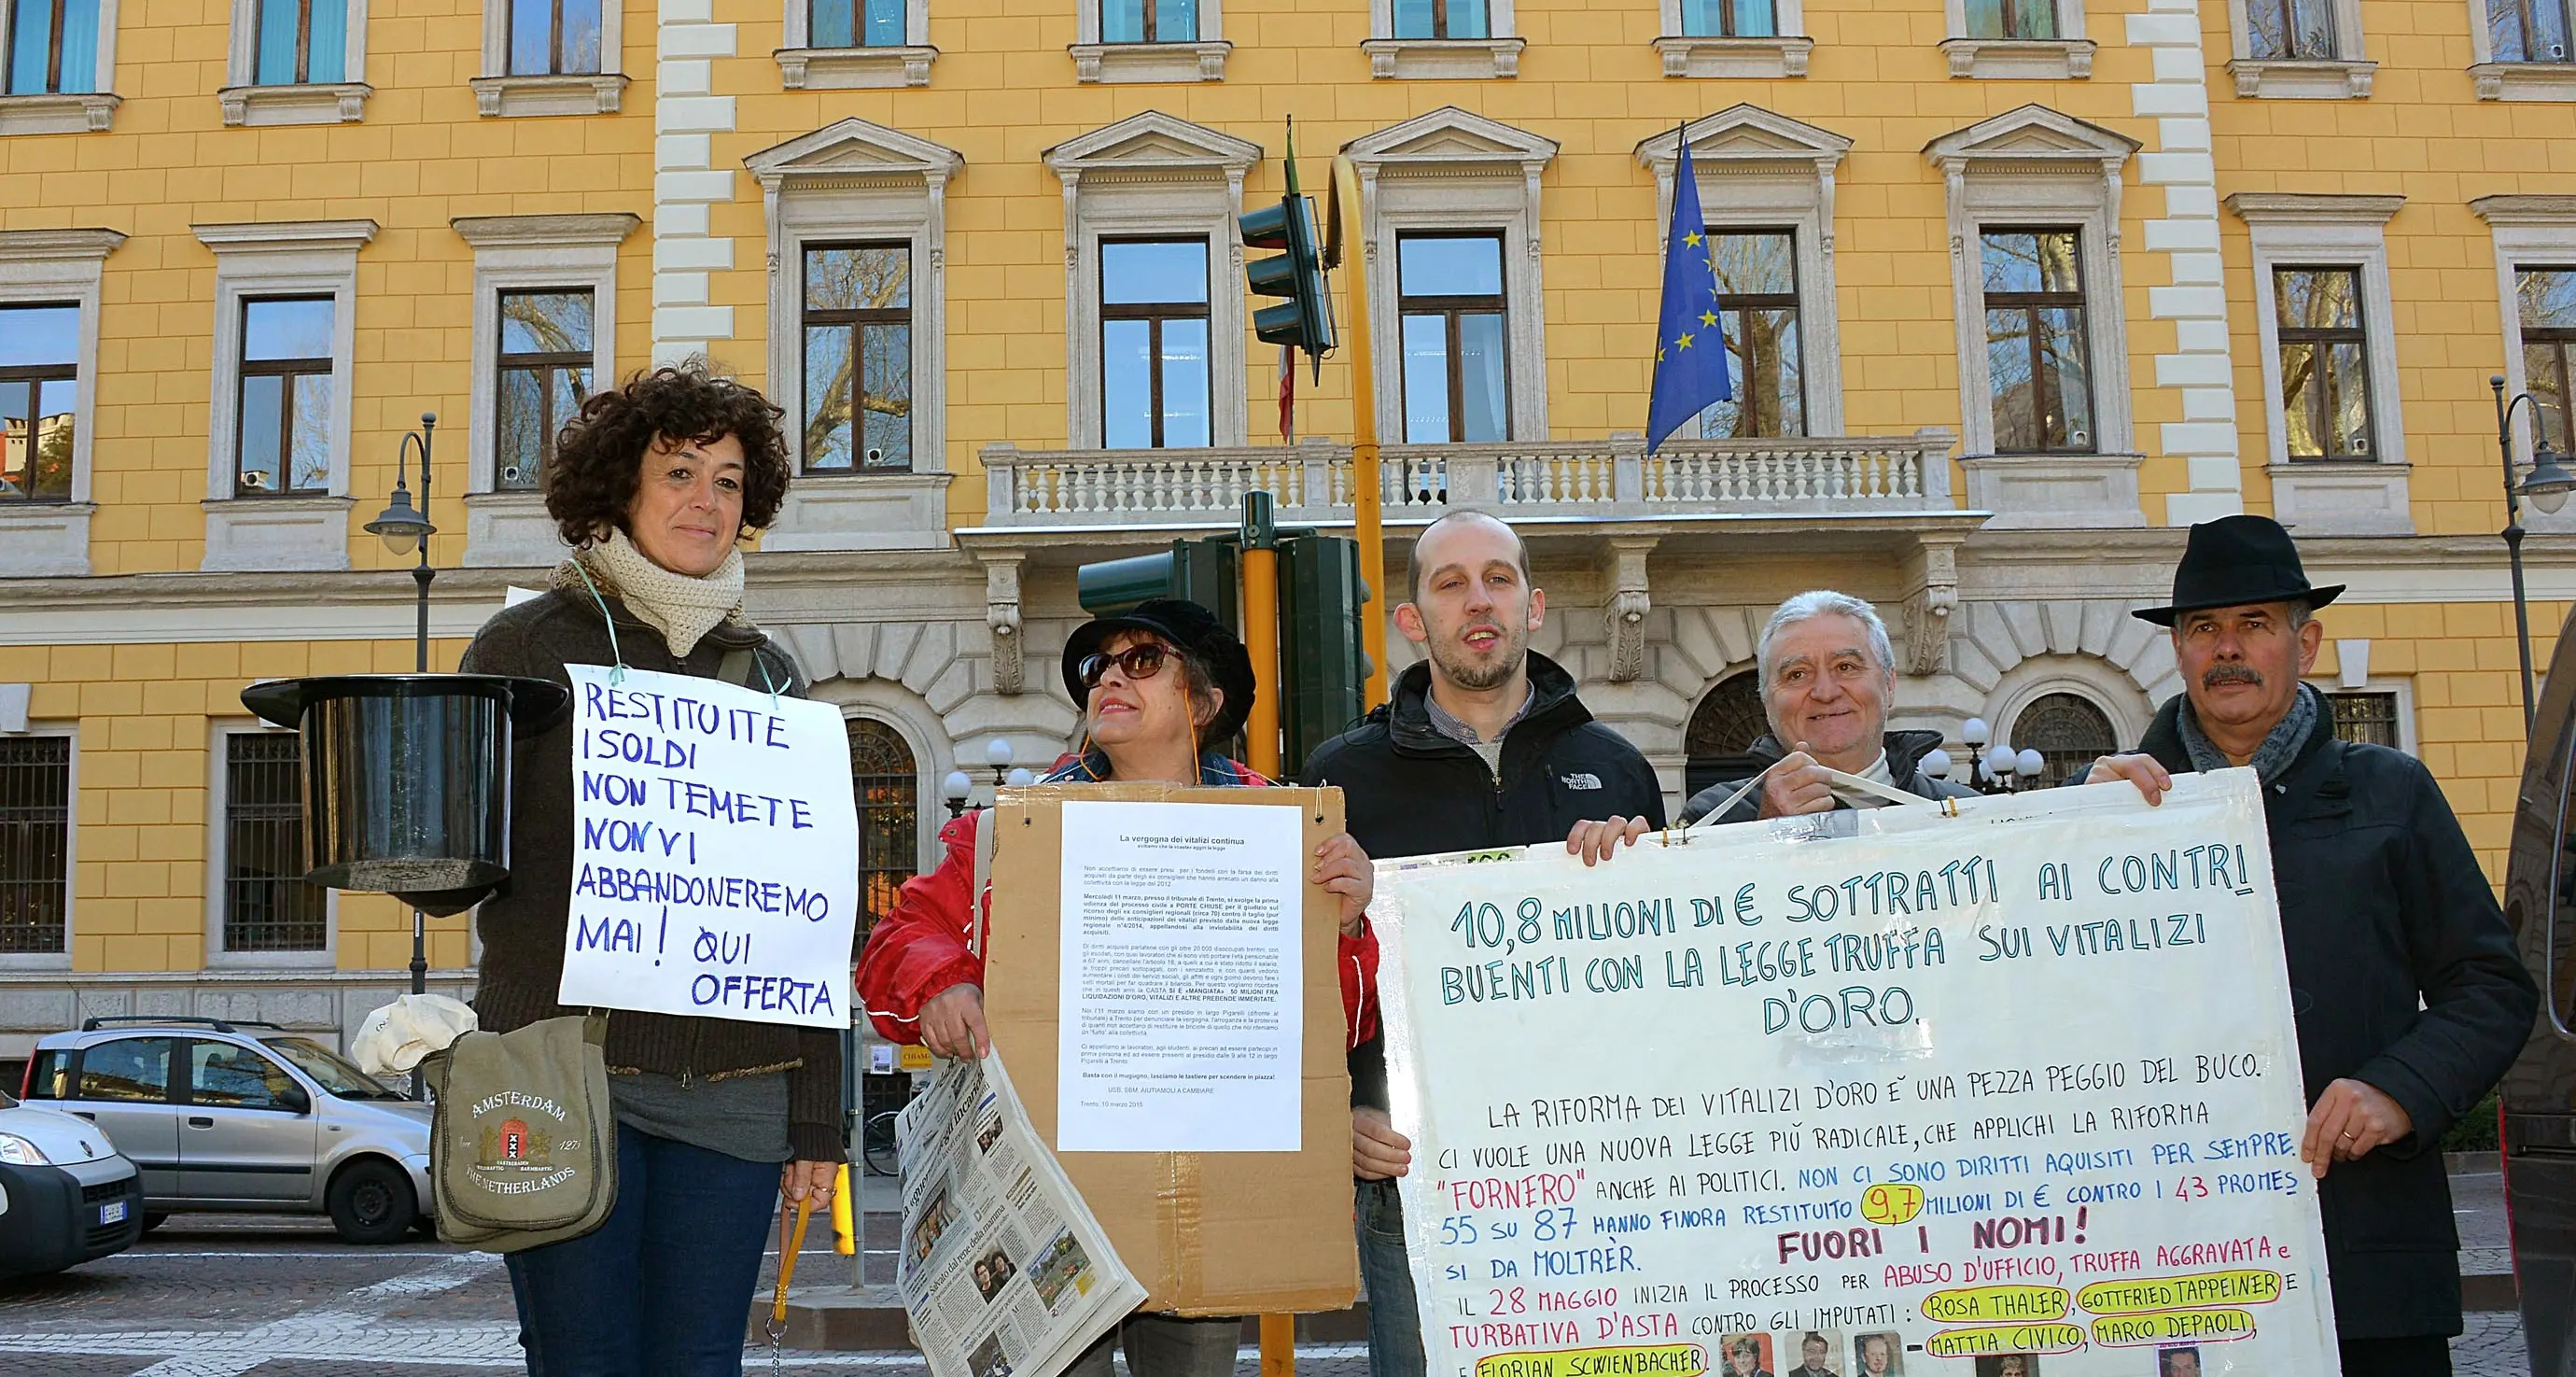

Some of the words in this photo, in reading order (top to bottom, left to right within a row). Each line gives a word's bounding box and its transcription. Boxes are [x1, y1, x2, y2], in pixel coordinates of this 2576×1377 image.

[586, 682, 790, 749] RESTITUITE
[583, 771, 646, 806] NON
[658, 778, 813, 829] TEMETE
[584, 818, 652, 852] NON
[659, 828, 695, 864] VI
[1131, 836, 1169, 844] vergogna
[1184, 836, 1210, 844] vitalizi
[1211, 836, 1245, 845] continua
[576, 864, 828, 922] ABBANDONEREMO
[1450, 897, 1543, 956] 10,8
[1552, 897, 1675, 941] MILIONI
[1690, 895, 1724, 928] DI
[1733, 882, 1763, 927] €
[1785, 854, 1999, 922] SOTTRATTI
[2038, 862, 2073, 902] AI
[2098, 843, 2254, 897] CONTRI
[693, 925, 750, 964] QUI
[1441, 955, 1570, 1005] BUENTI
[1585, 953, 1643, 994] CON
[1665, 948, 1704, 989] LA
[1719, 937, 1816, 986] LEGGE
[1824, 927, 1946, 973] TRUFFA
[1979, 924, 2033, 962] SUI
[2046, 912, 2207, 957] VITALIZI
[692, 974, 834, 1017] OFFERTA
[1763, 988, 1922, 1035] D'ORO.
[471, 1090, 566, 1122] AMSTERDAM
[1488, 1100, 1520, 1129] LA
[1533, 1095, 1642, 1128] RIFORMA
[1652, 1096, 1686, 1119] DEI
[1701, 1088, 1800, 1117] VITALIZI
[1813, 1079, 1878, 1110] D'ORO
[1916, 1075, 1956, 1101] UNA
[1967, 1069, 2035, 1098] PEZZA
[2045, 1062, 2126, 1093] PEGGIO
[2140, 1057, 2179, 1085] DEL
[2195, 1052, 2261, 1085] BUCO.
[1438, 1148, 1460, 1171] CI
[1472, 1145, 1531, 1171] VUOLE
[1546, 1141, 1586, 1164] UNA
[1600, 1135, 1673, 1160] NUOVA
[1688, 1131, 1755, 1159] LEGGE
[1972, 1113, 2055, 1140] APPLICHI
[2072, 1110, 2098, 1134] LA
[2110, 1101, 2210, 1131] RIFORMA
[482, 1166, 576, 1195] NETHERLANDS
[1437, 1169, 1586, 1212] "FORNERO"
[1595, 1175, 1657, 1201] ANCHE
[1668, 1173, 1687, 1198] AI
[1698, 1168, 1786, 1197] POLITICI.
[1798, 1165, 1839, 1190] NON
[1852, 1165, 1872, 1185] CI
[1887, 1159, 1946, 1185] SONO
[1955, 1154, 2031, 1177] DIRITTI
[2045, 1148, 2134, 1174] AQUISITI
[2151, 1142, 2195, 1165] PER
[2203, 1131, 2297, 1160] SEMPRE.
[1440, 1215, 1477, 1245] 55
[1491, 1221, 1519, 1241] SU
[1533, 1207, 1578, 1243] 87
[1592, 1214, 1652, 1235] HANNO
[1660, 1208, 1727, 1229] FINORA
[1743, 1200, 1853, 1225] RESTITUITO
[1867, 1187, 1919, 1227] 9,7
[1924, 1193, 1993, 1215] MILIONI
[2004, 1187, 2025, 1209] DI
[2033, 1184, 2051, 1209] €
[2065, 1177, 2142, 1205] CONTRO
[2155, 1177, 2163, 1199] I
[2173, 1174, 2210, 1203] 43
[2217, 1169, 2299, 1195] PROMES
[930, 1272, 950, 1297] Salvato
[982, 1204, 1006, 1234] mamma
[1446, 1264, 1466, 1282] SI
[1491, 1258, 1519, 1279] DA
[1776, 1226, 1883, 1265] FUORI
[1917, 1225, 1930, 1254] I
[1457, 1297, 1477, 1316] IL
[1490, 1286, 1526, 1315] 28
[1538, 1286, 1618, 1313] MAGGIO
[1633, 1284, 1687, 1304] INIZIA
[1705, 1283, 1718, 1301] IL
[1728, 1274, 1819, 1300] PROCESSO
[1841, 1272, 1870, 1290] PER
[1883, 1261, 1953, 1288] ABUSO
[1964, 1255, 2064, 1286] D'UFFICIO,
[2069, 1249, 2141, 1273] TRUFFA
[2157, 1235, 2272, 1268] AGGRAVATA
[1449, 1320, 1580, 1350] TURBATIVA
[1596, 1310, 1679, 1341] D'ASTA
[1691, 1312, 1757, 1337] CONTRO
[1771, 1308, 1799, 1331] GLI
[1929, 1296, 1980, 1319] ROSA
[2081, 1286, 2172, 1309] GOTTFRIED
[2174, 1272, 2278, 1302] TAPPEINER
[2286, 1273, 2299, 1290] E
[1931, 1332, 1999, 1356] MATTIA
[2095, 1320, 2155, 1343] MARCO
